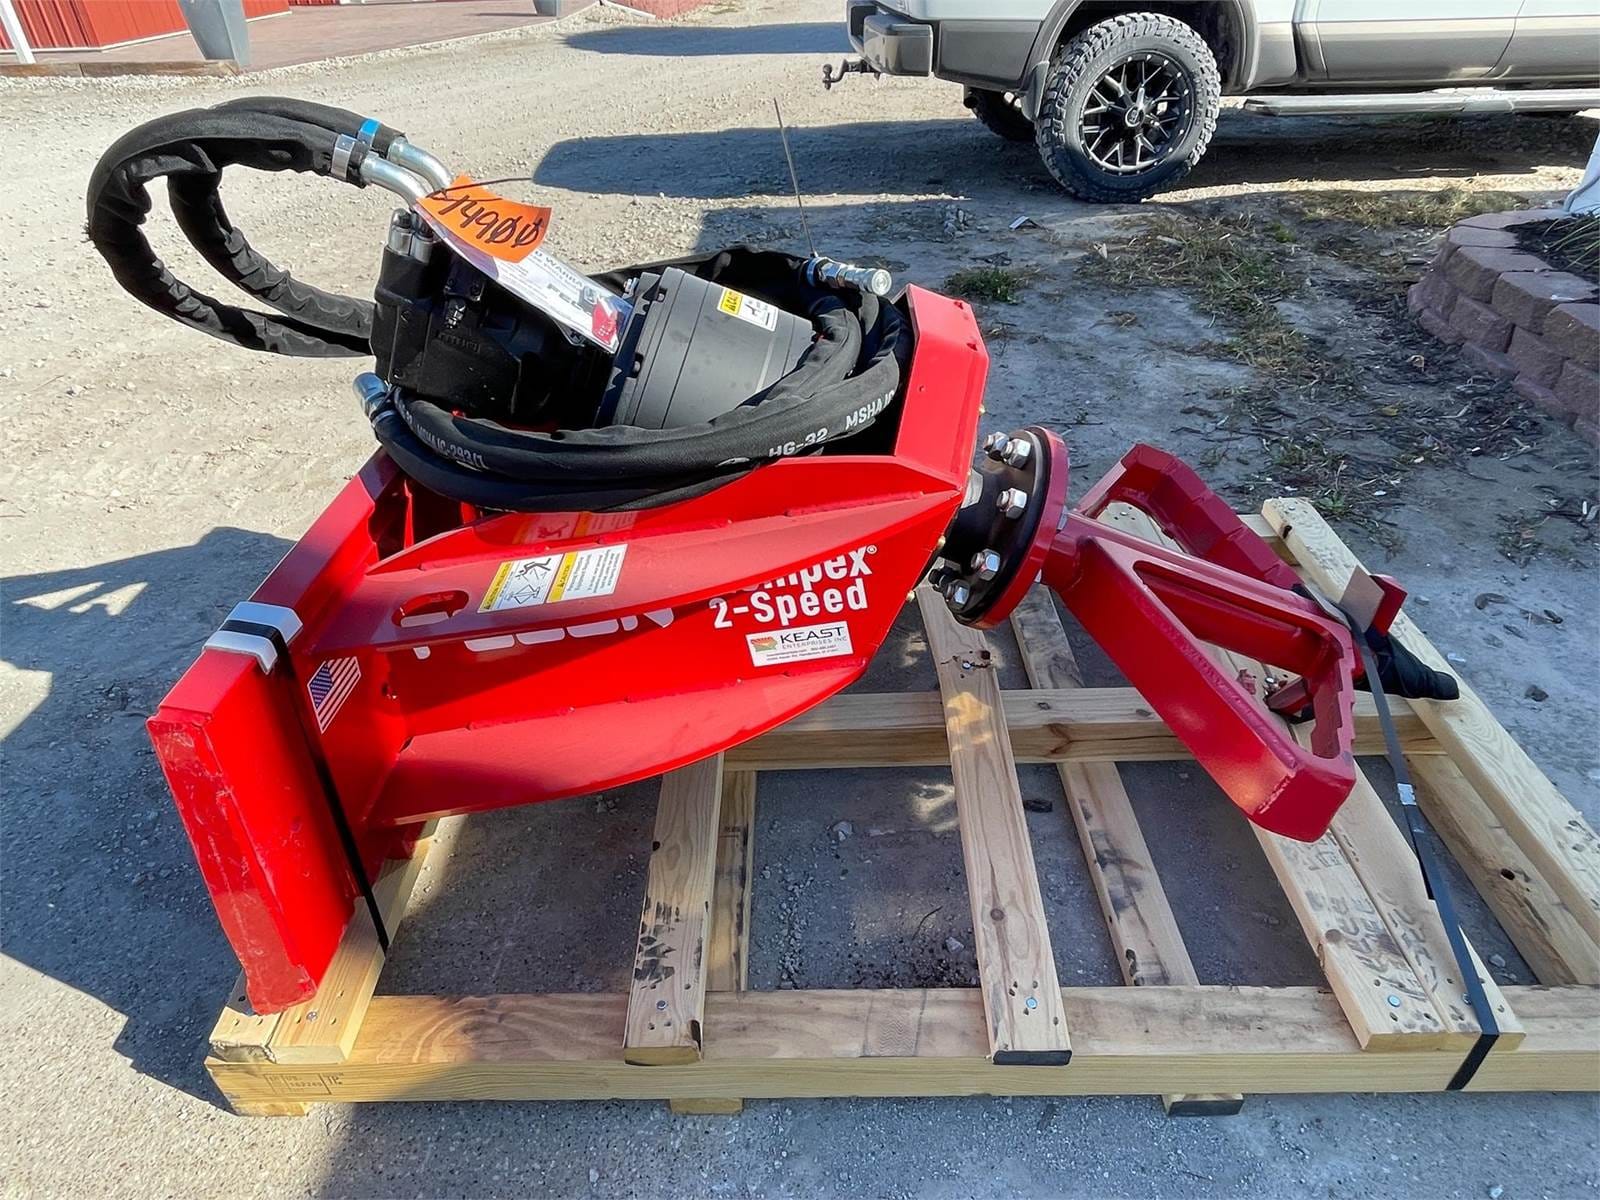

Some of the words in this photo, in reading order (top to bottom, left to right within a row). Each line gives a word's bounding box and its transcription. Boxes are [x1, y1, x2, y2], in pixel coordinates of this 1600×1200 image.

[708, 577, 869, 629] 2-Speed
[780, 625, 844, 644] KEAST
[782, 638, 833, 650] ENTERPRISES
[834, 635, 848, 644] INC
